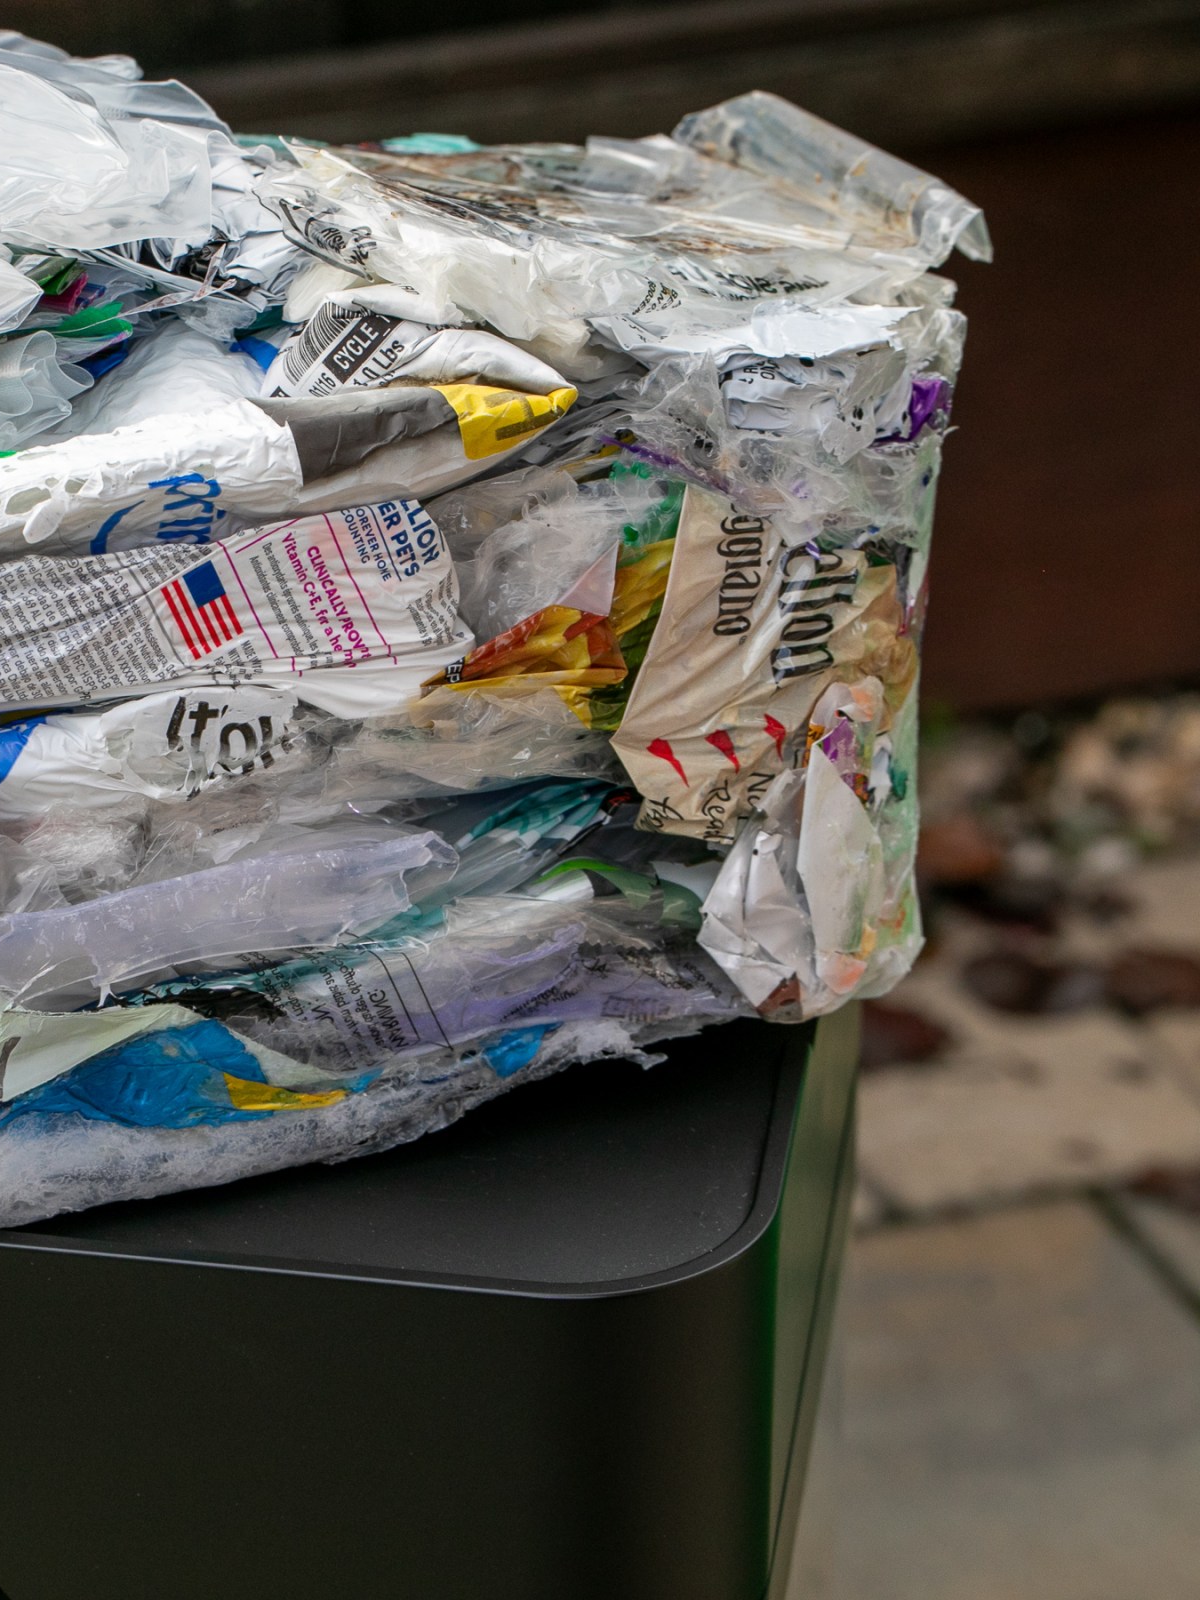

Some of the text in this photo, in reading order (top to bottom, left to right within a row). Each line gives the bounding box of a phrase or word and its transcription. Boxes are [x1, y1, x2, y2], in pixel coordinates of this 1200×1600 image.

[330, 320, 380, 372] CYCLE
[371, 335, 406, 371] Lbs
[279, 531, 311, 582] Vitamin
[389, 529, 423, 578] PETS
[305, 544, 348, 618] CLINICALLY
